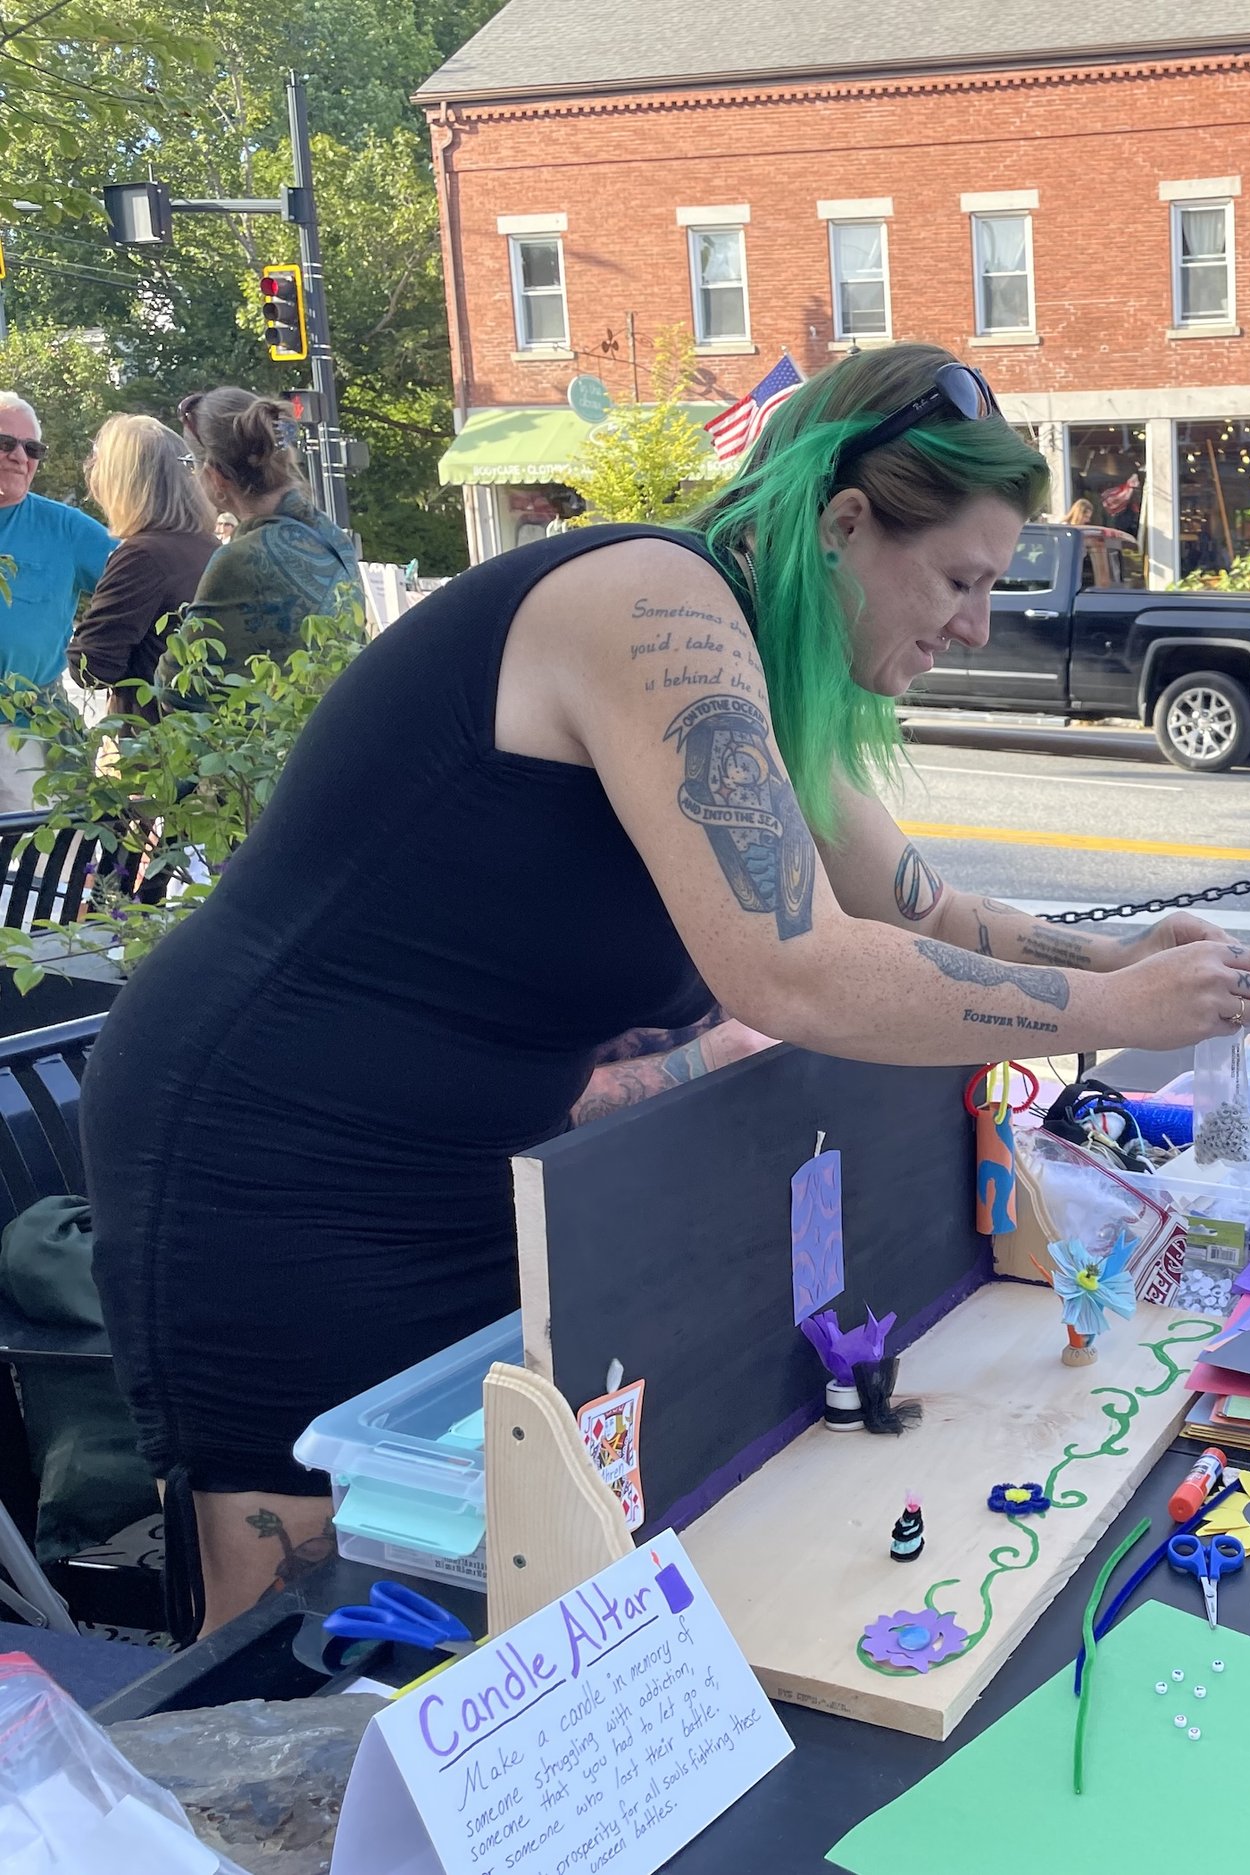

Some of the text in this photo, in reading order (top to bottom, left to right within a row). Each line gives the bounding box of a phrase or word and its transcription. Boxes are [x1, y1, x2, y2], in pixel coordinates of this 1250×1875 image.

[664, 665, 724, 688] behind
[686, 634, 724, 652] take
[712, 700, 731, 711] THE
[732, 701, 765, 723] OCEAN
[681, 798, 779, 830] AND INTO THE SEA
[419, 1582, 652, 1757] Candle Altar
[458, 1614, 694, 1812] Make a candle in memory of
[466, 1662, 694, 1838] someone struggling with addiction,
[470, 1814, 530, 1862] someone
[540, 1780, 570, 1812] that
[583, 1755, 608, 1784] you
[612, 1726, 634, 1756] had
[640, 1717, 653, 1735] to
[659, 1696, 675, 1724] let
[683, 1689, 697, 1709] go
[505, 1820, 565, 1868] someone
[576, 1791, 604, 1816] who
[615, 1758, 639, 1789] lost
[645, 1737, 674, 1765] their
[681, 1702, 720, 1738] battle.
[619, 1799, 639, 1825] for
[645, 1777, 661, 1803] all
[663, 1761, 689, 1790] souls
[688, 1732, 735, 1771] fighting
[730, 1708, 761, 1735] these
[590, 1800, 678, 1875] unseen battles.
